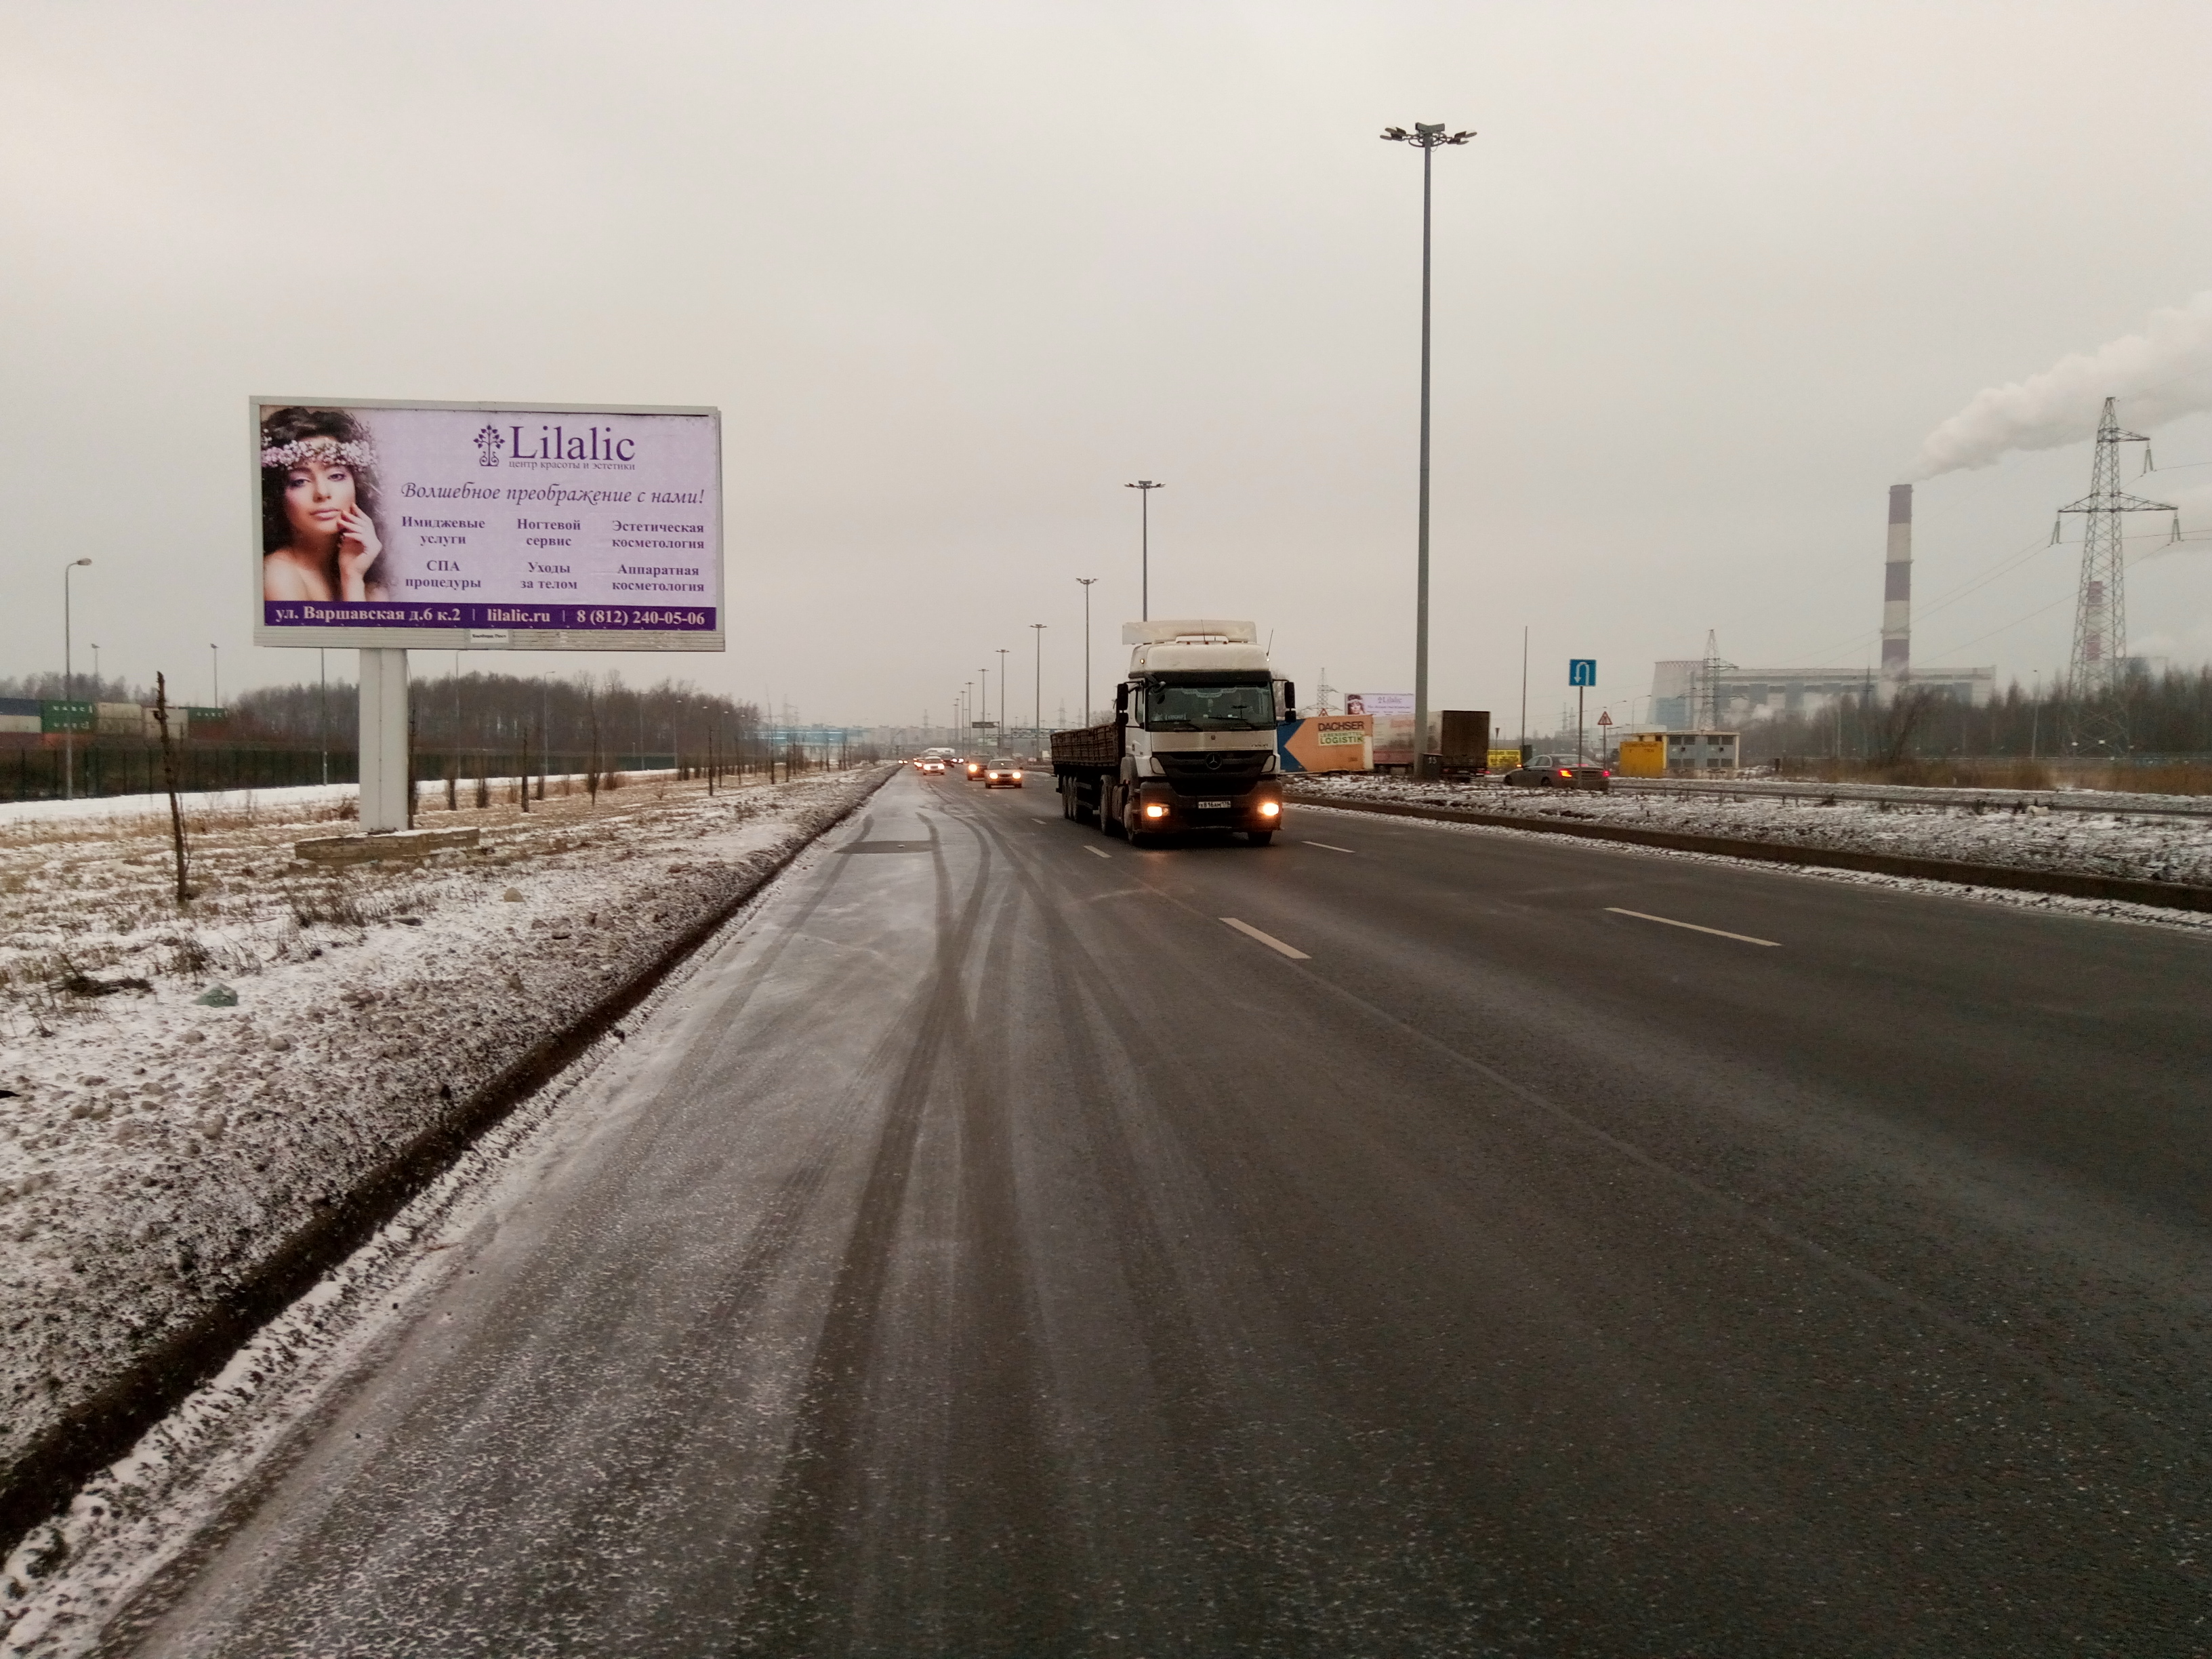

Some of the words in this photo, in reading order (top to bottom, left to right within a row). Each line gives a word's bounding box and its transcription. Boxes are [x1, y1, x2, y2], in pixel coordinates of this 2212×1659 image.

[509, 425, 636, 462] Lilalic
[509, 460, 537, 470] центр
[540, 461, 580, 470] красоты
[401, 481, 500, 499] Волшебное
[506, 483, 632, 506] преображение
[637, 493, 646, 503] с
[651, 489, 705, 504] нами!
[402, 516, 485, 529] Имиджевые
[517, 518, 581, 531] Ногтевой
[612, 520, 704, 533] Эстетическая
[419, 535, 466, 546] услуги
[526, 537, 572, 548] сервис
[612, 538, 704, 549] косметология
[426, 560, 461, 572] СПА
[527, 561, 571, 574] Уходы
[617, 564, 699, 577] Аппаратная
[405, 578, 481, 590] процедуры
[520, 581, 534, 589] за
[538, 581, 577, 590] телом
[612, 581, 704, 592] косметология
[275, 609, 299, 622] ул.
[303, 606, 405, 623] Варшавская
[409, 608, 433, 621] д.6
[437, 608, 461, 621] к.2
[487, 609, 550, 622] lilalic.ru
[577, 610, 586, 622] 8
[590, 610, 628, 626] (812)
[632, 611, 705, 624] 240-05-06
[1317, 721, 1364, 731] DACHSER
[1320, 736, 1364, 744] LOGISTIK
